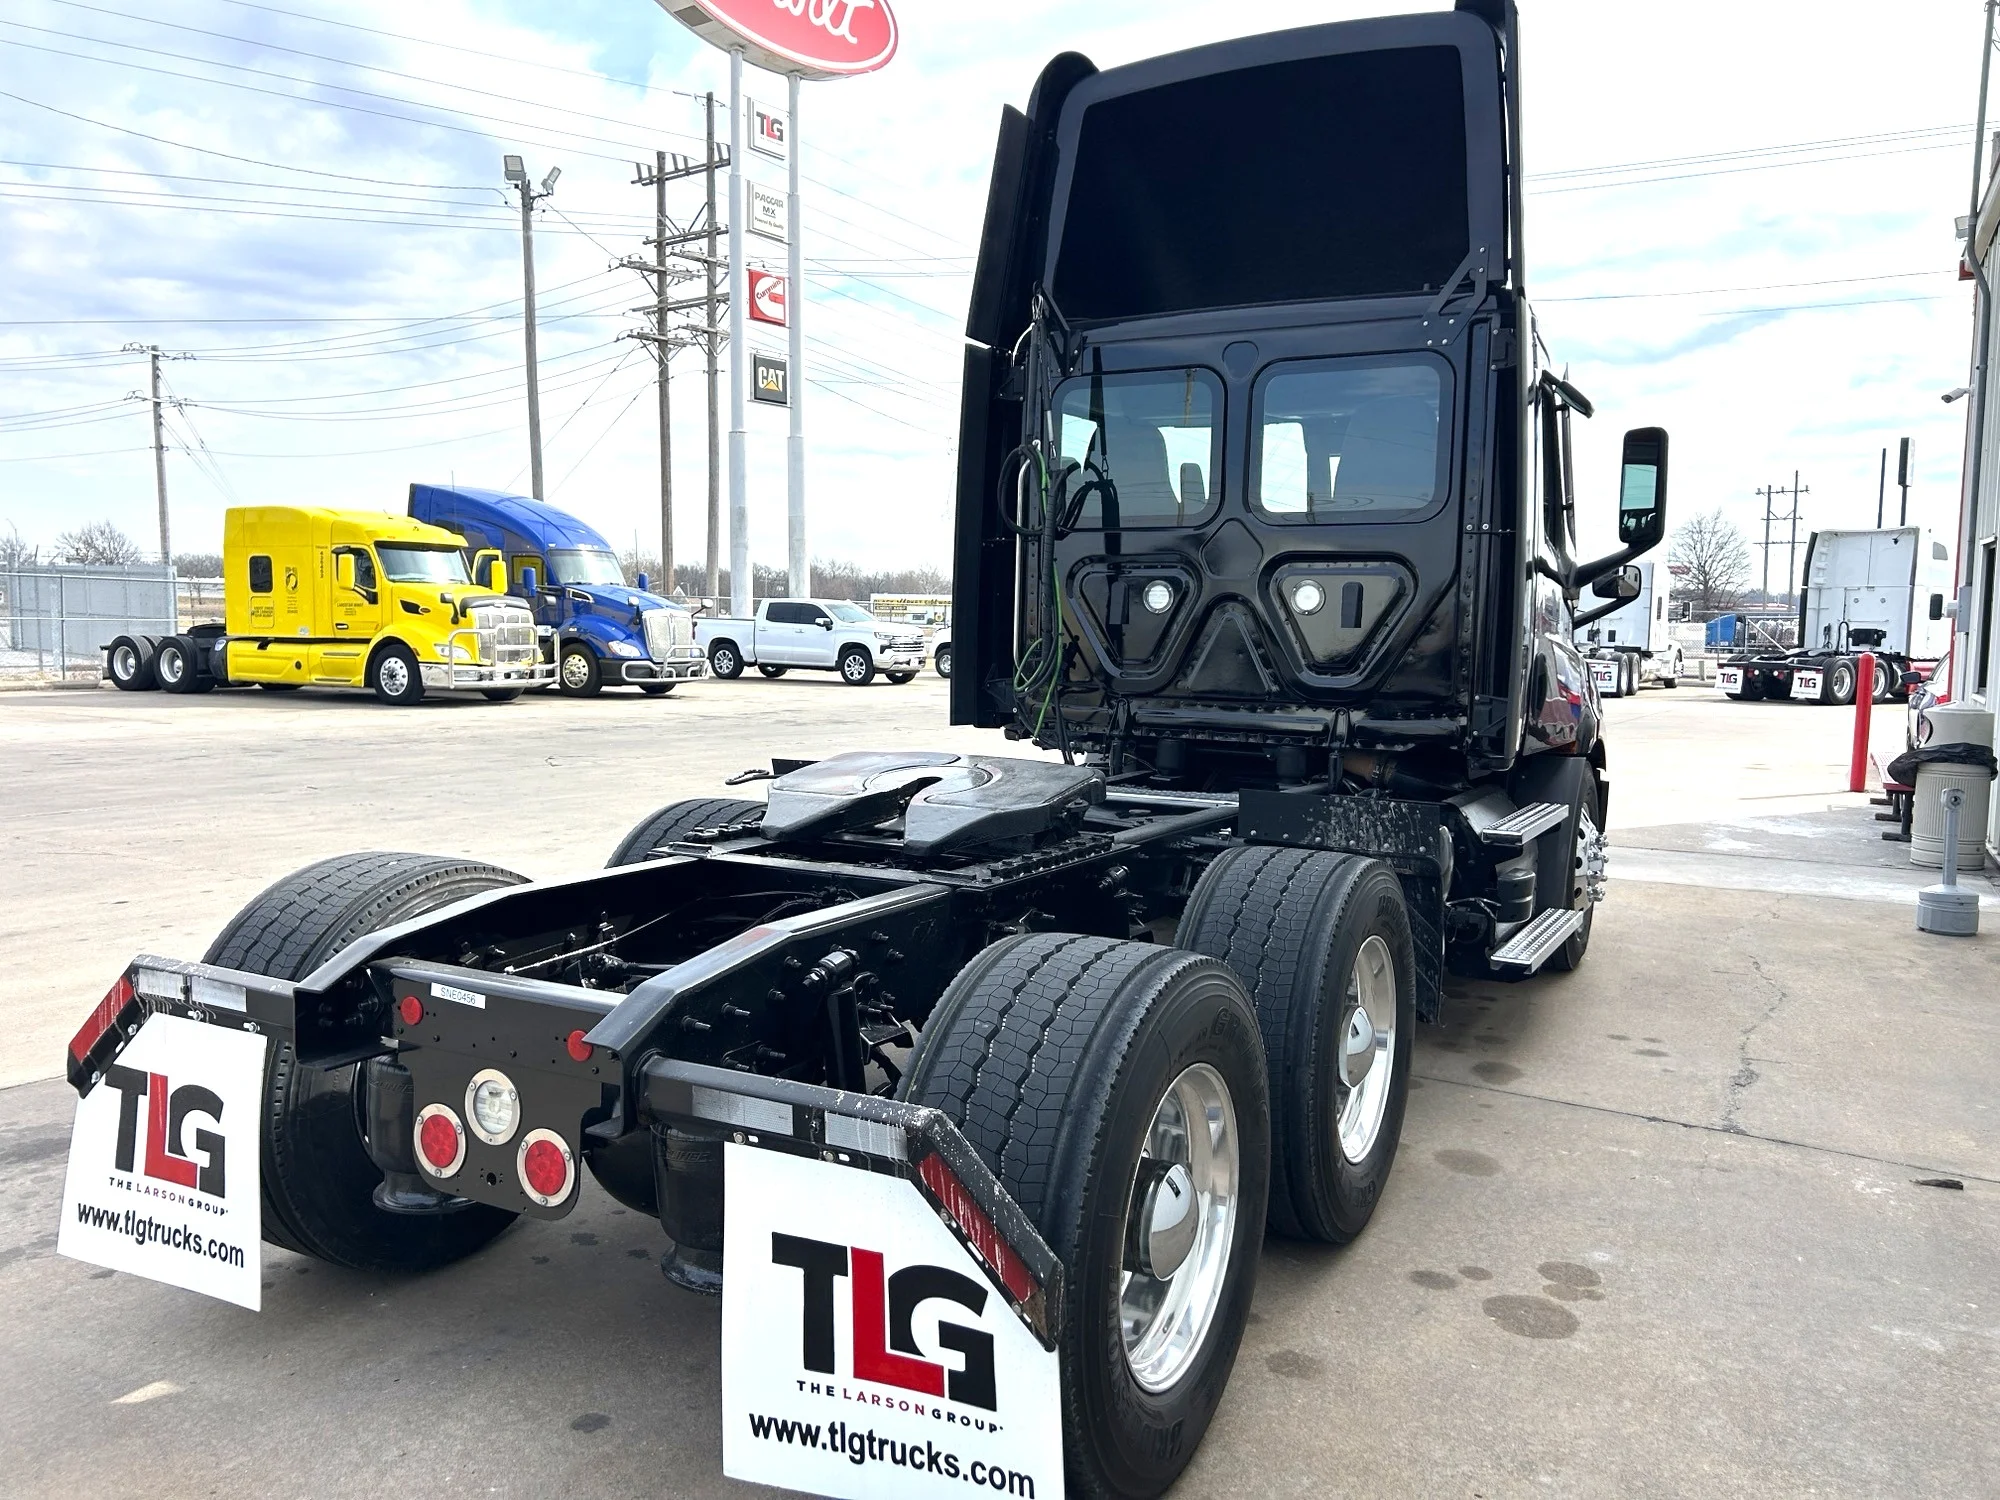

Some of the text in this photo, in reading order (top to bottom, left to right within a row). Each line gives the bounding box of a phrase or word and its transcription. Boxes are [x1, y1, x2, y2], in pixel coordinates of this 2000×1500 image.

[756, 111, 784, 142] TLG
[755, 191, 784, 209] PACCAR
[762, 205, 776, 216] MX
[756, 279, 782, 300] Cummins
[758, 366, 785, 392] CAT
[1593, 671, 1612, 682] TLG
[1720, 673, 1738, 684] TLG
[1797, 677, 1817, 689] TLG
[104, 1063, 226, 1199] TLG
[109, 1177, 226, 1216] THE LARSON GROUP
[77, 1202, 245, 1268] www.tlgtrucks.com
[771, 1231, 998, 1412] TLG
[796, 1379, 998, 1433] THE LARSON GROUP
[748, 1412, 1036, 1500] www.tlgtrucks.com
